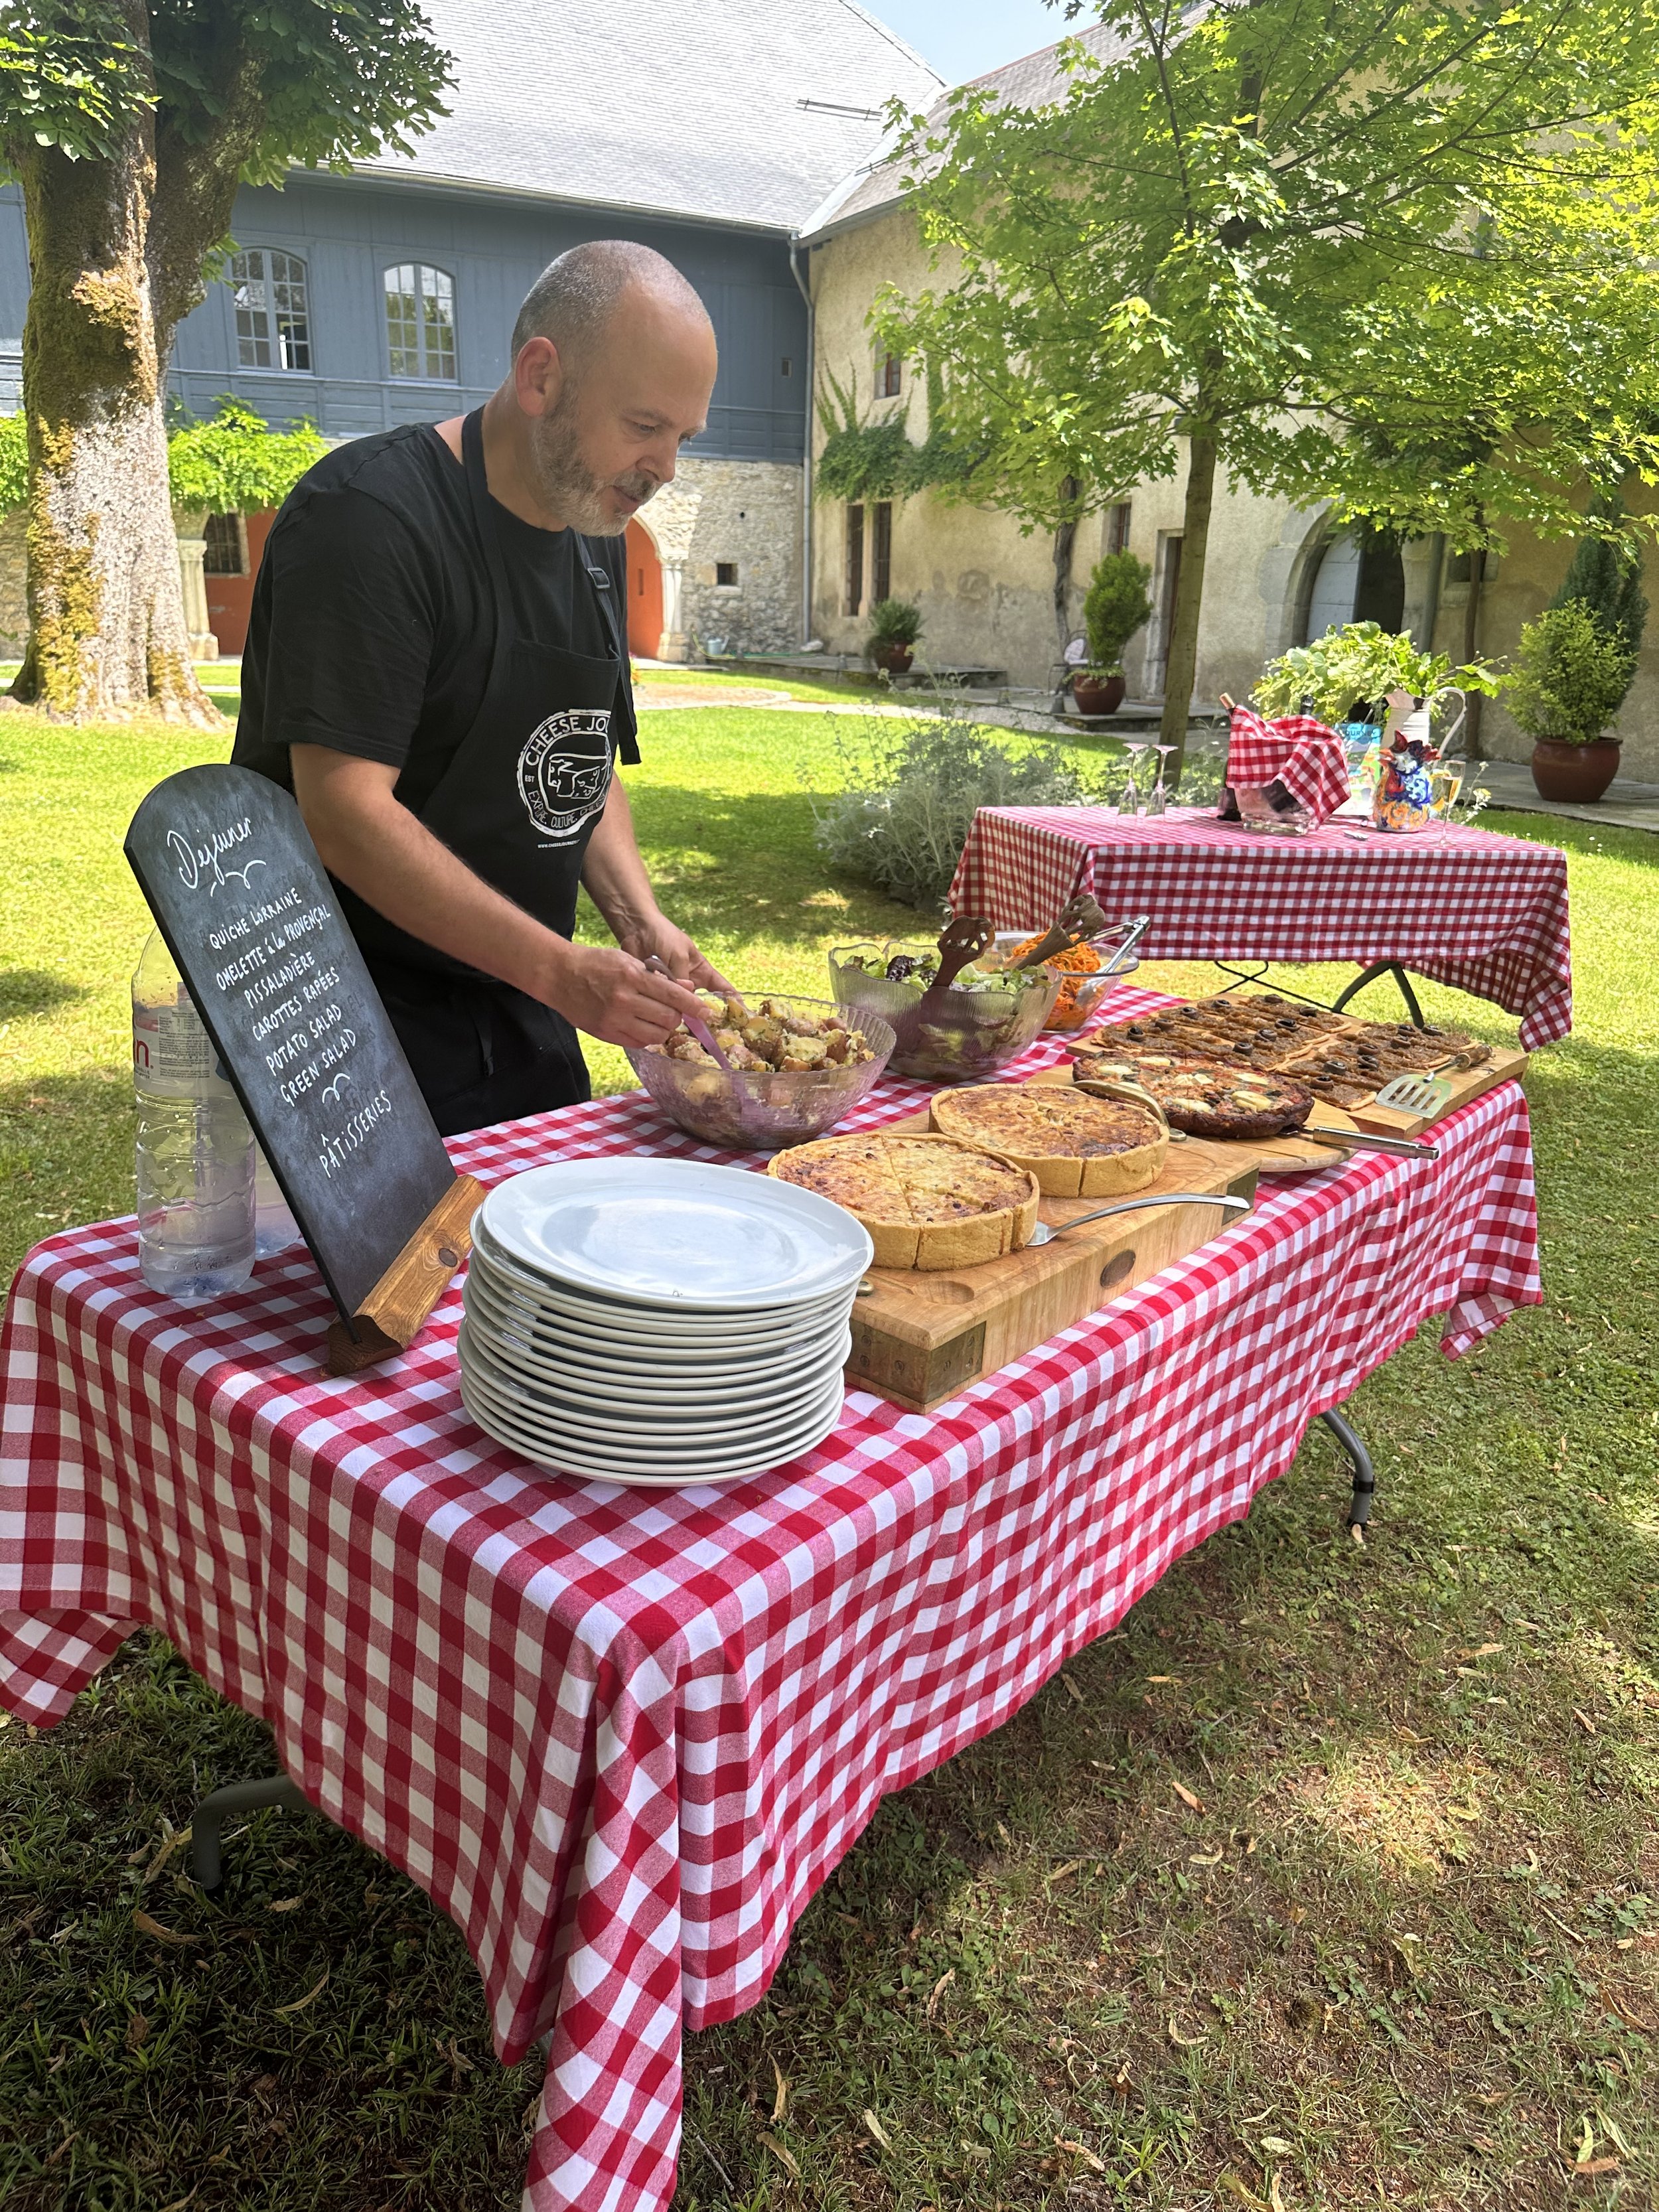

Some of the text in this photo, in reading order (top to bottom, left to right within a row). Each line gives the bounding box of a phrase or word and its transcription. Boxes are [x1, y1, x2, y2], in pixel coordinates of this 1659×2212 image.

[525, 716, 581, 766] CHEESE
[209, 918, 251, 950] QUICHE
[216, 946, 267, 991] OMELETTE
[271, 932, 285, 950] la
[283, 904, 331, 942] PROVENÇAL
[244, 951, 315, 1009] PISSALADIÈRE
[252, 966, 340, 1041] CAROTTES RAPÉES
[265, 1003, 342, 1076] POTATO SALAD
[280, 1029, 356, 1107] GREEN SALAD
[319, 1090, 392, 1179] PÂTISSERIES
